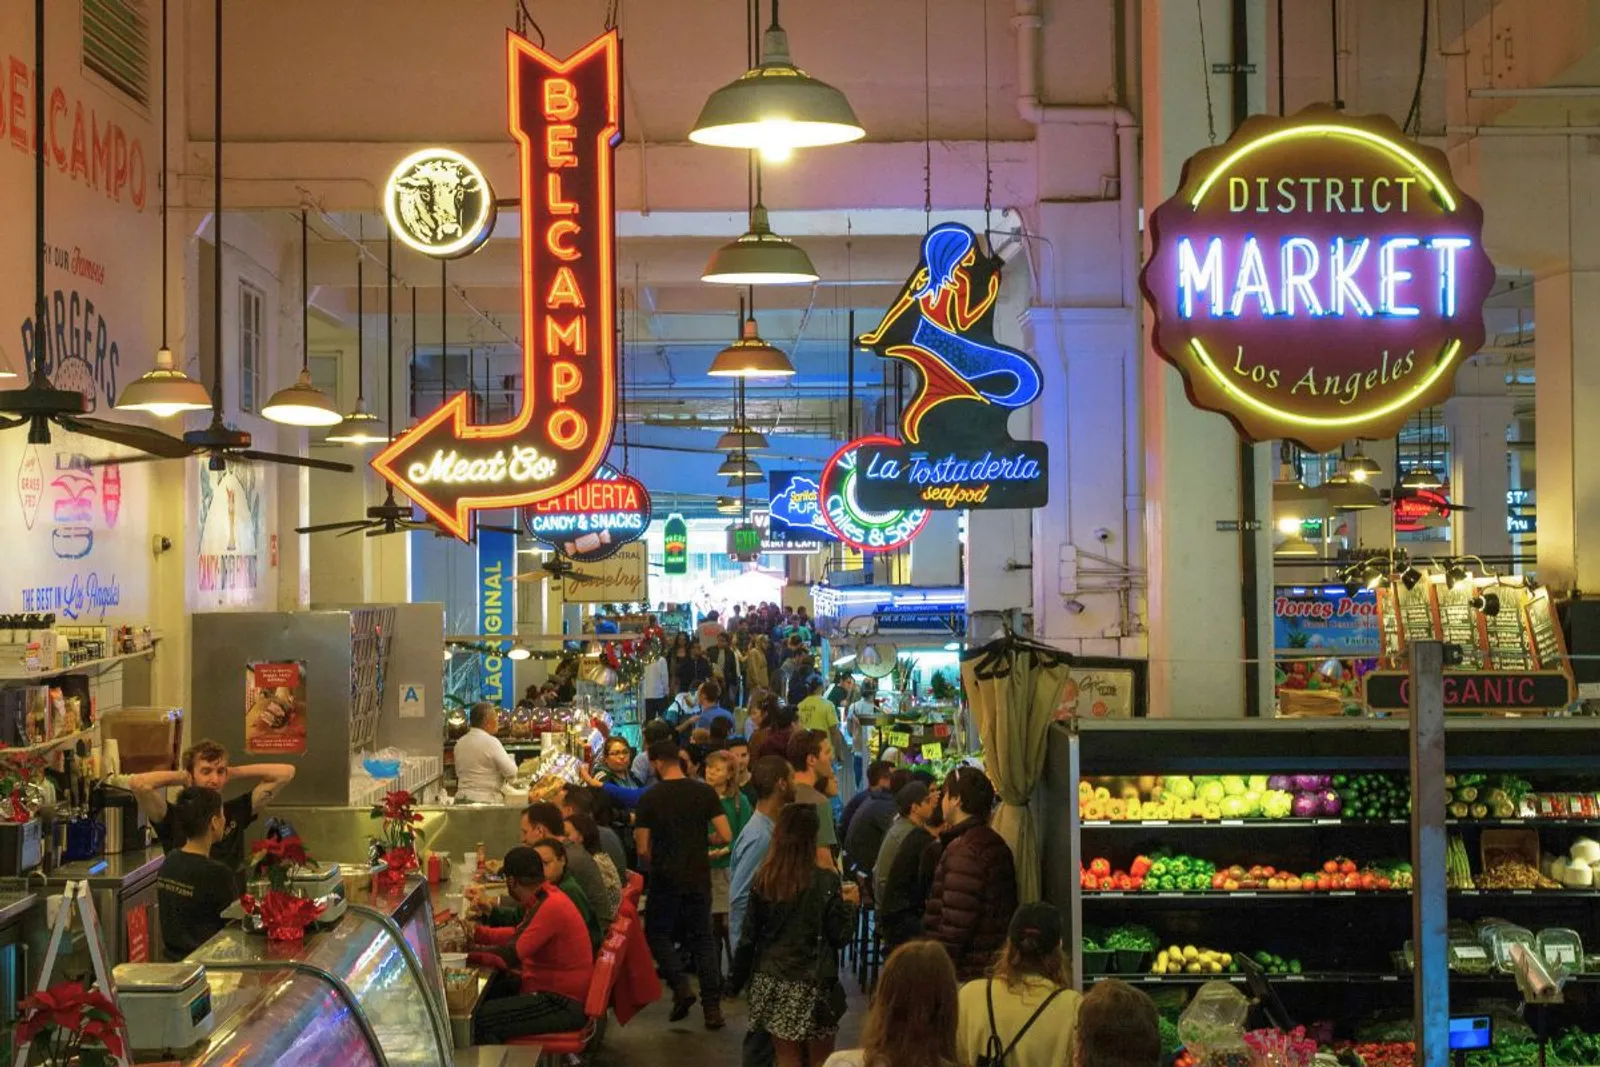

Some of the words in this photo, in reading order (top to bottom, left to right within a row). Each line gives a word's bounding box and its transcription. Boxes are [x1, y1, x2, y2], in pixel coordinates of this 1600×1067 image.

[0, 54, 146, 213] ELCAMPO
[1228, 177, 1417, 213] DISTRICT
[543, 78, 588, 450] BELCAMPO
[1177, 235, 1472, 320] MARKET
[21, 290, 120, 409] BURGERS
[1233, 346, 1281, 389] Los
[1291, 349, 1416, 404] Angeles
[408, 449, 507, 483] Meat
[866, 452, 901, 479] La
[908, 452, 1041, 484] Tostadería
[566, 483, 638, 511] HUERTA
[921, 483, 990, 508] seafood
[532, 514, 576, 531] CANDY
[578, 514, 588, 530] &
[590, 511, 642, 529] SNACKS
[826, 494, 865, 542] Chiles
[868, 528, 885, 546] &
[884, 509, 927, 545] Spic
[735, 531, 759, 545] EXIT
[22, 590, 34, 611] THE
[36, 587, 53, 611] BEST
[63, 574, 83, 620] Los
[1274, 597, 1333, 619] Torres
[404, 686, 419, 702] A
[1399, 677, 1536, 705] OGANIC
